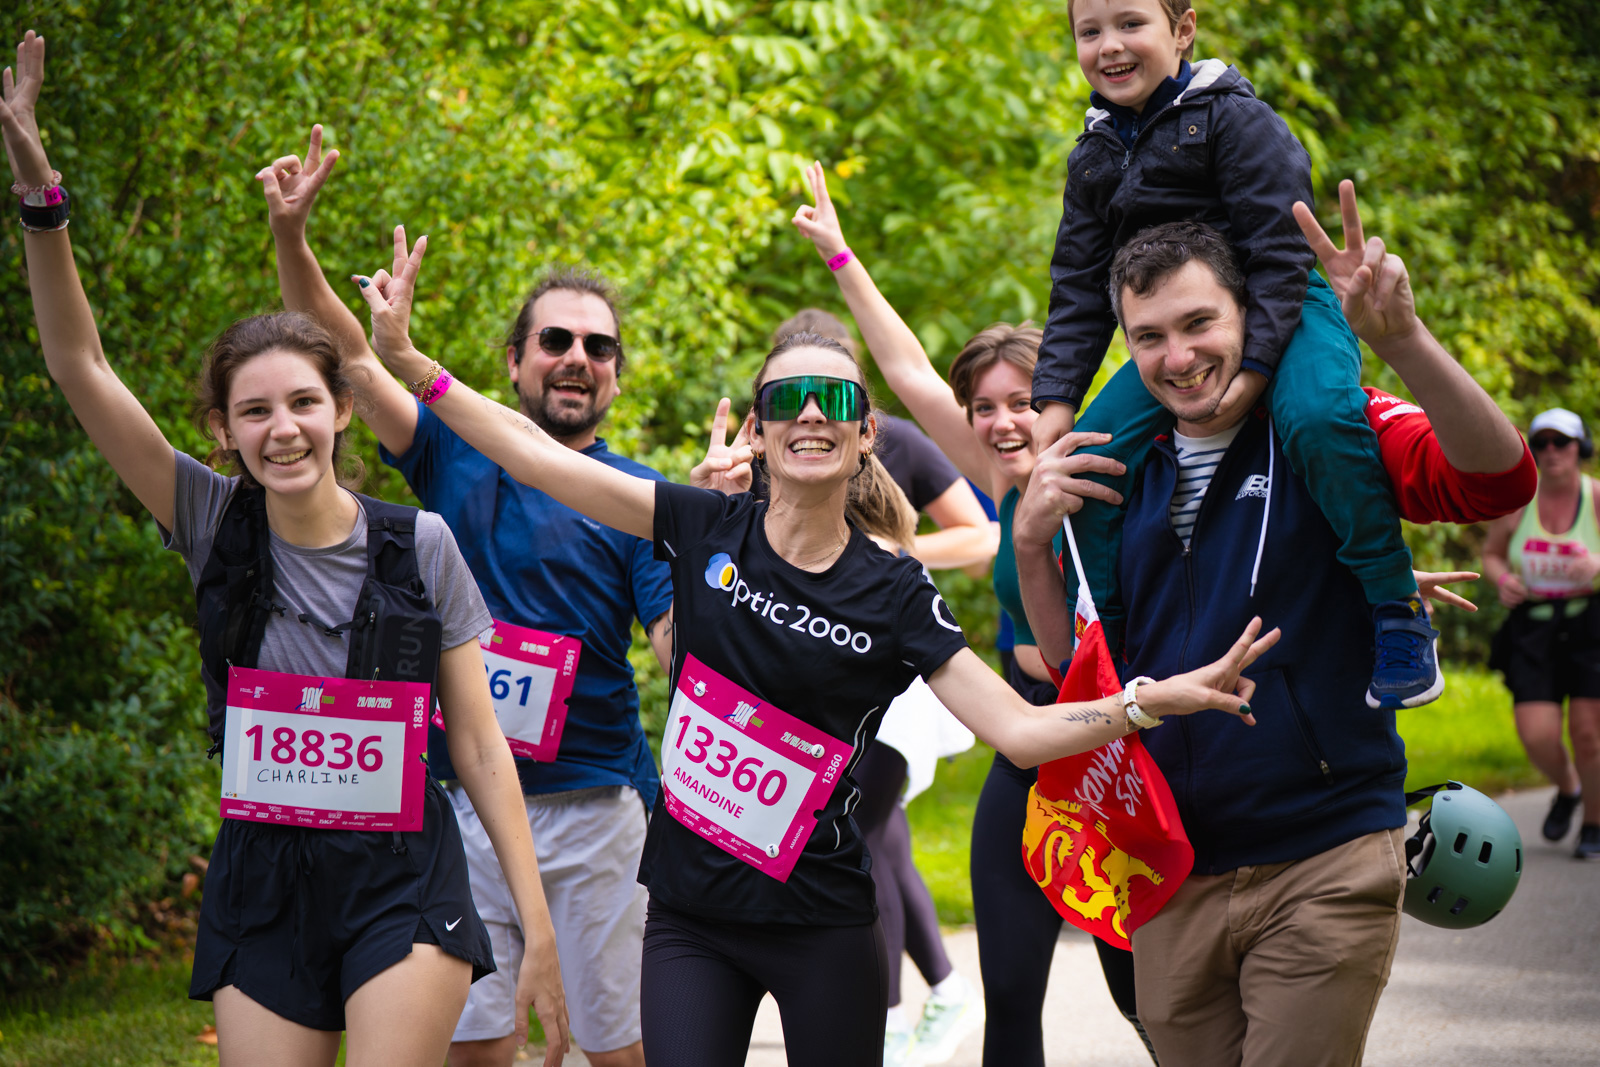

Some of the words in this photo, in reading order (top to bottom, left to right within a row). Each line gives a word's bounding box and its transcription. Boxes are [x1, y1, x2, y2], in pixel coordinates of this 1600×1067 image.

[718, 562, 790, 625] Optic
[788, 604, 873, 654] 2000
[563, 649, 576, 676] 13361
[301, 686, 324, 710] 10K
[485, 663, 533, 707] 61
[412, 696, 425, 730] 18836
[729, 700, 758, 728] 10K
[245, 724, 384, 773] 18836
[675, 714, 788, 808] 13360
[256, 768, 360, 785] CHARLINE
[821, 753, 844, 786] 13360
[672, 766, 746, 820] AMANDINE
[789, 825, 804, 849] AMANDINE
